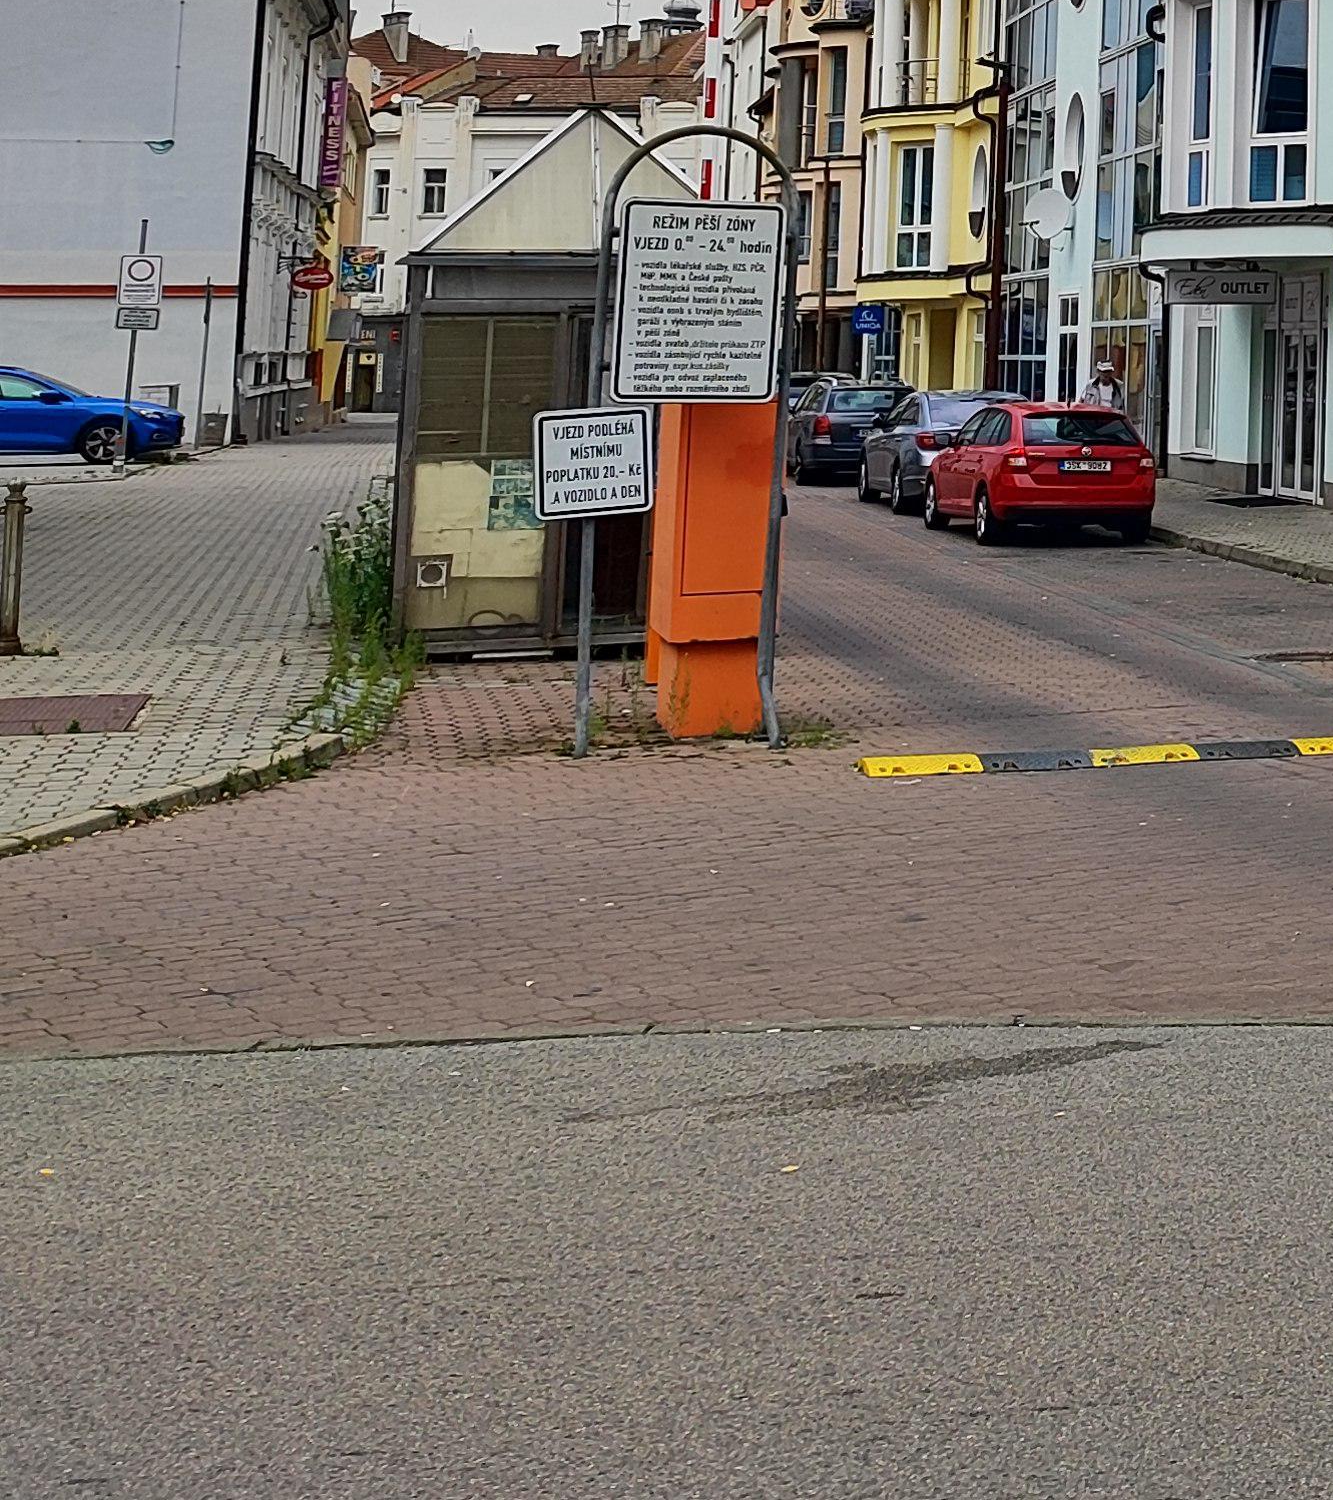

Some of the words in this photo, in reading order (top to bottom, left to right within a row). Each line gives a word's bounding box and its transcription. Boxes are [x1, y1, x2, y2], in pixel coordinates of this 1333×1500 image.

[325, 81, 343, 161] FITNESS
[652, 213, 689, 230] REŽIM
[695, 214, 721, 231] PĚŠÍ
[726, 215, 756, 231] ZÓNY
[634, 236, 669, 250] VJEZD
[740, 240, 772, 254] hodin
[1220, 282, 1270, 294] OUTLET
[750, 340, 766, 348] ZTP
[552, 425, 584, 440] VJEZD
[588, 419, 635, 438] PODLÉHÁ
[570, 441, 622, 460] MÍSTNÍMU
[545, 466, 600, 483] POPLATKU
[628, 463, 642, 477] Kč
[563, 487, 607, 504] VOZIDLO
[610, 487, 618, 500] A
[620, 484, 641, 499] DEN
